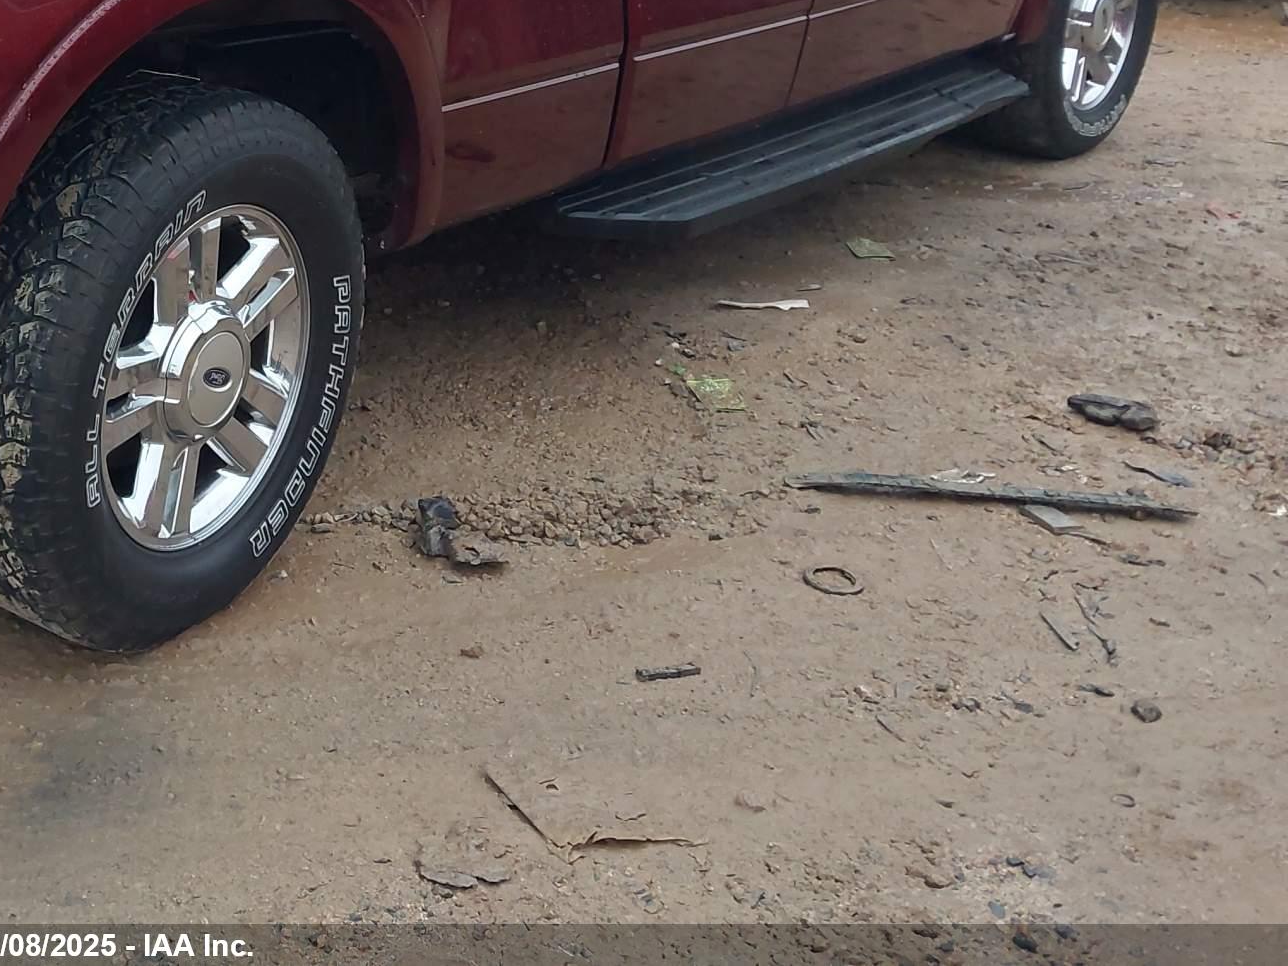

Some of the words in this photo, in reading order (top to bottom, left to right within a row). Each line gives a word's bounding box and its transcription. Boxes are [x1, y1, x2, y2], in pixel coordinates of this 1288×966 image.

[92, 189, 207, 399] TERRAIN
[85, 413, 101, 508] ALL
[249, 275, 352, 558] PATHFINDER
